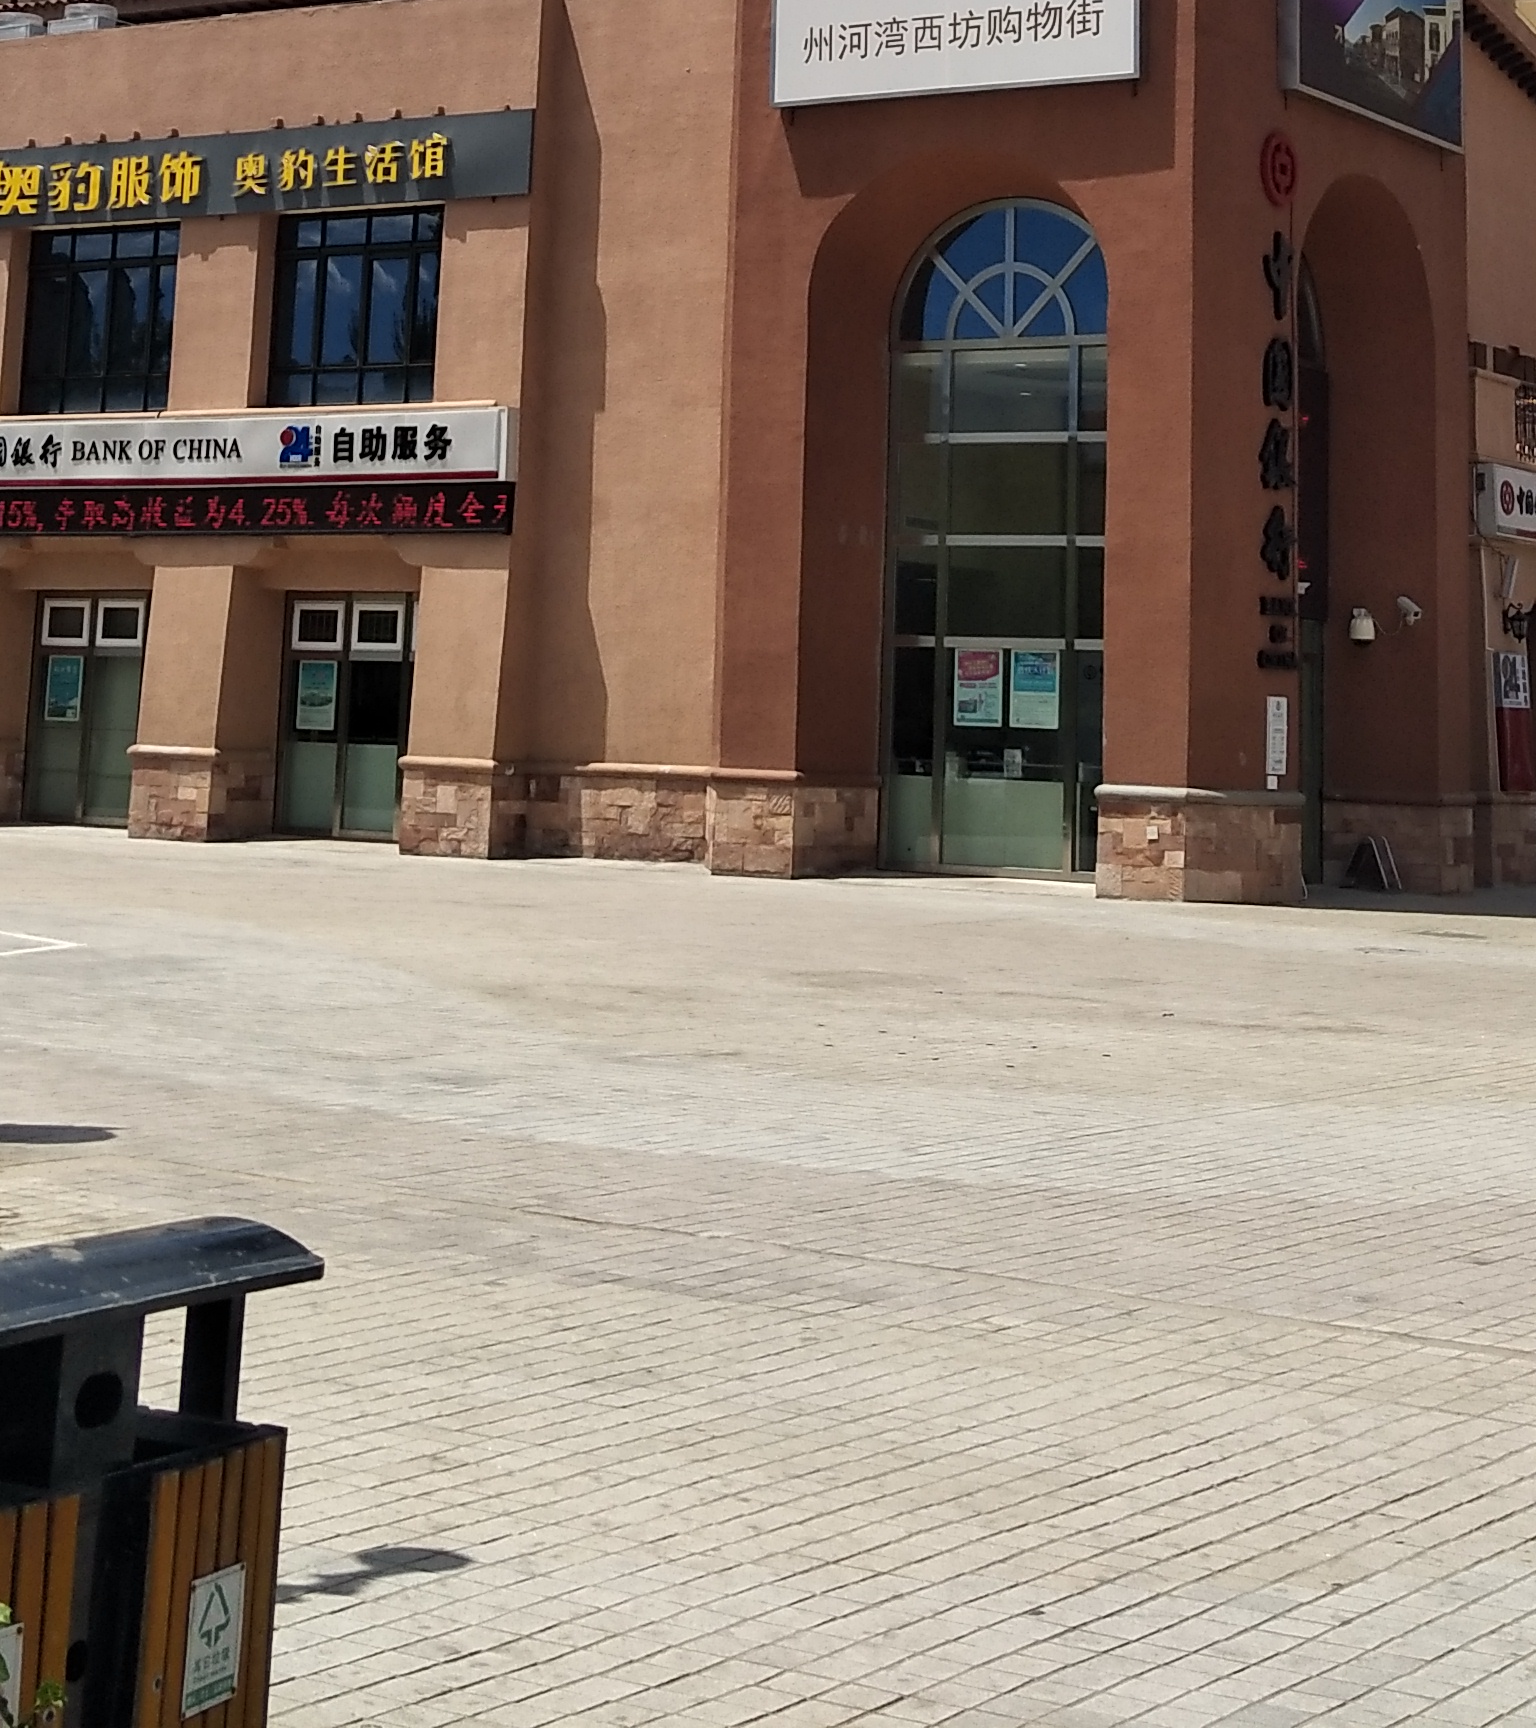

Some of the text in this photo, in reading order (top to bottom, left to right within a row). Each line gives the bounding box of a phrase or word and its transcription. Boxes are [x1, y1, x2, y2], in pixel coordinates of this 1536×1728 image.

[71, 437, 242, 462] BANK OF CHINA
[333, 424, 452, 463] 自助服务
